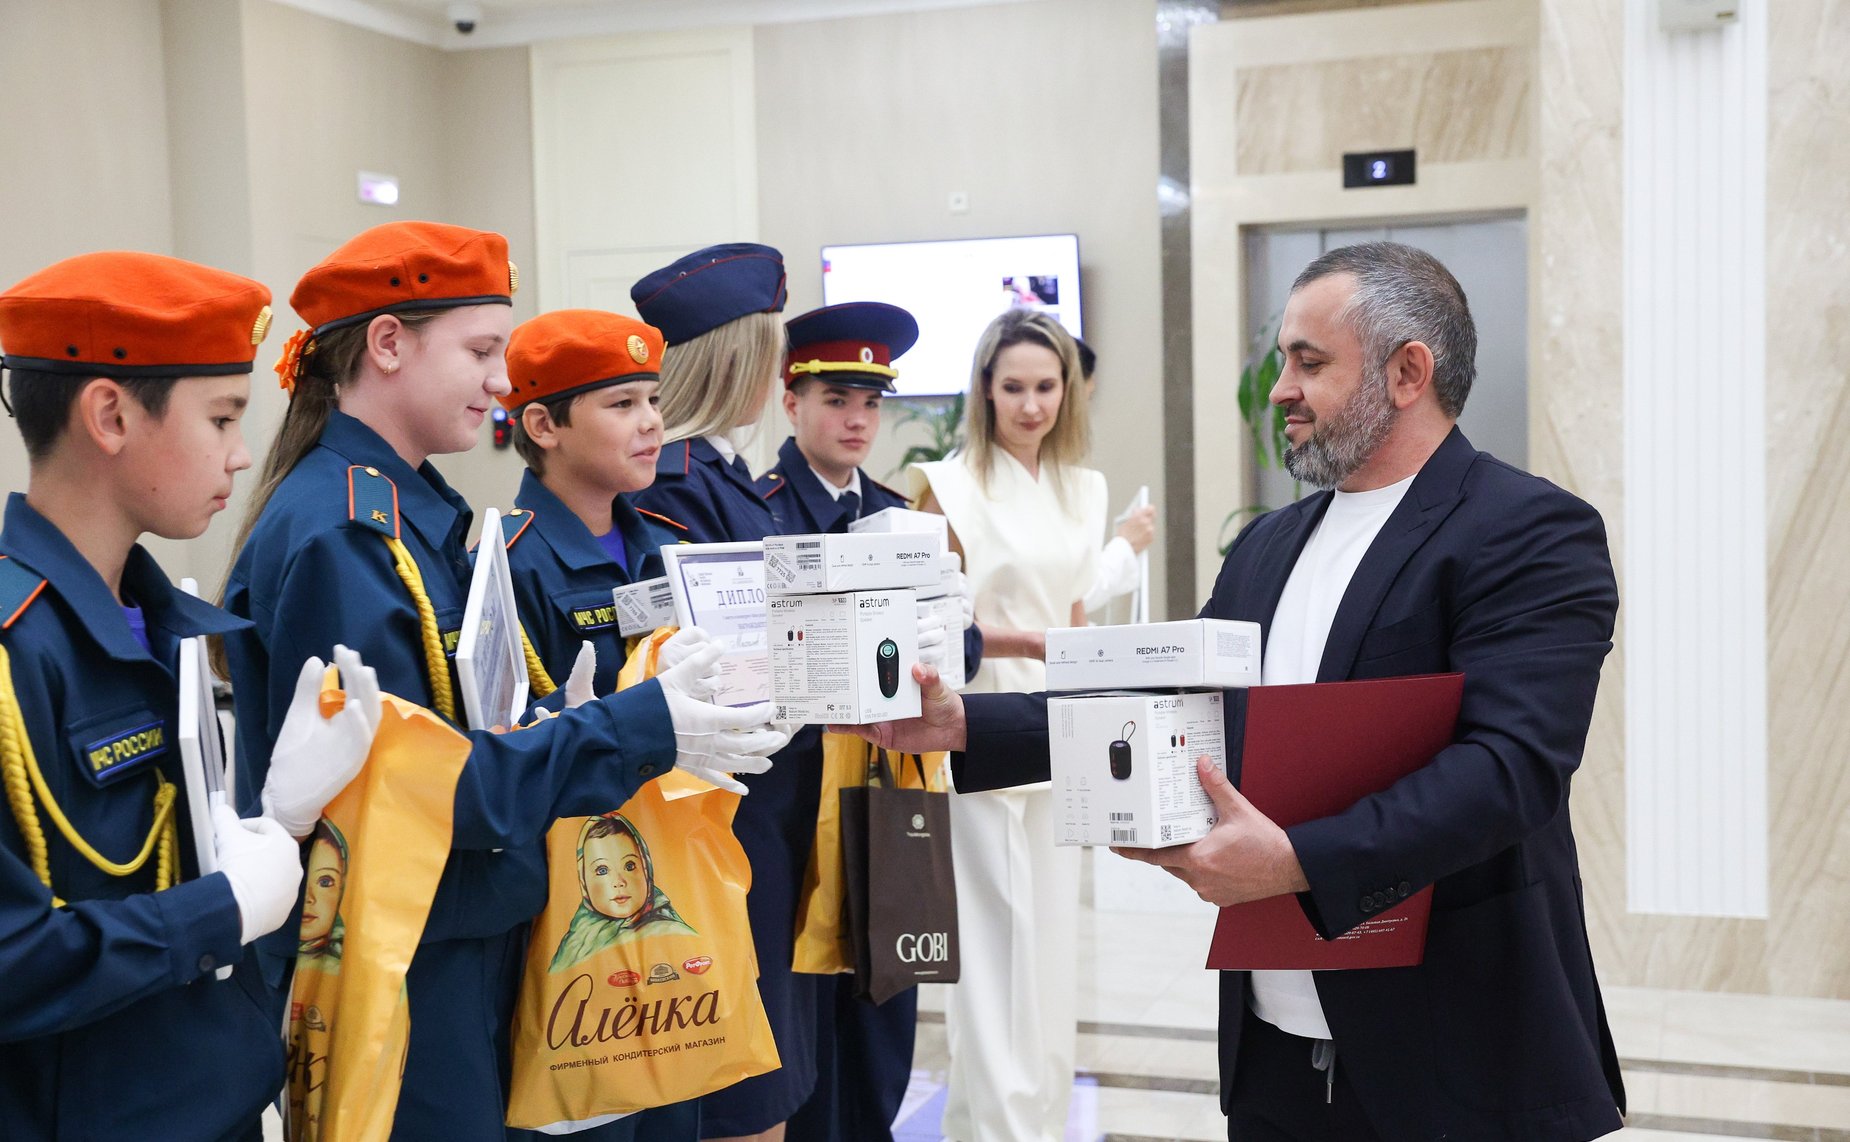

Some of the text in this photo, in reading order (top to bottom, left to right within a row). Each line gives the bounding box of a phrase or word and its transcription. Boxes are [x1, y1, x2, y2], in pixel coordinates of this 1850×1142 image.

[1372, 160, 1386, 179] 2
[896, 552, 913, 560] REDMI
[921, 551, 931, 559] Pro
[716, 587, 765, 608] ДИПЛО
[771, 599, 803, 608] astrum
[859, 598, 890, 608] astrum
[594, 605, 617, 624] РОС
[1136, 647, 1159, 655] REDMI
[1161, 646, 1171, 654] A7
[1153, 698, 1184, 709] astrum
[112, 727, 164, 762] РОССИИ
[896, 932, 949, 963] GOBI
[546, 973, 721, 1050] Алёнка
[550, 1036, 726, 1071] ФИРМЕННЫЙ КОНДИТЕРСКИЙ МАГАЗИН
